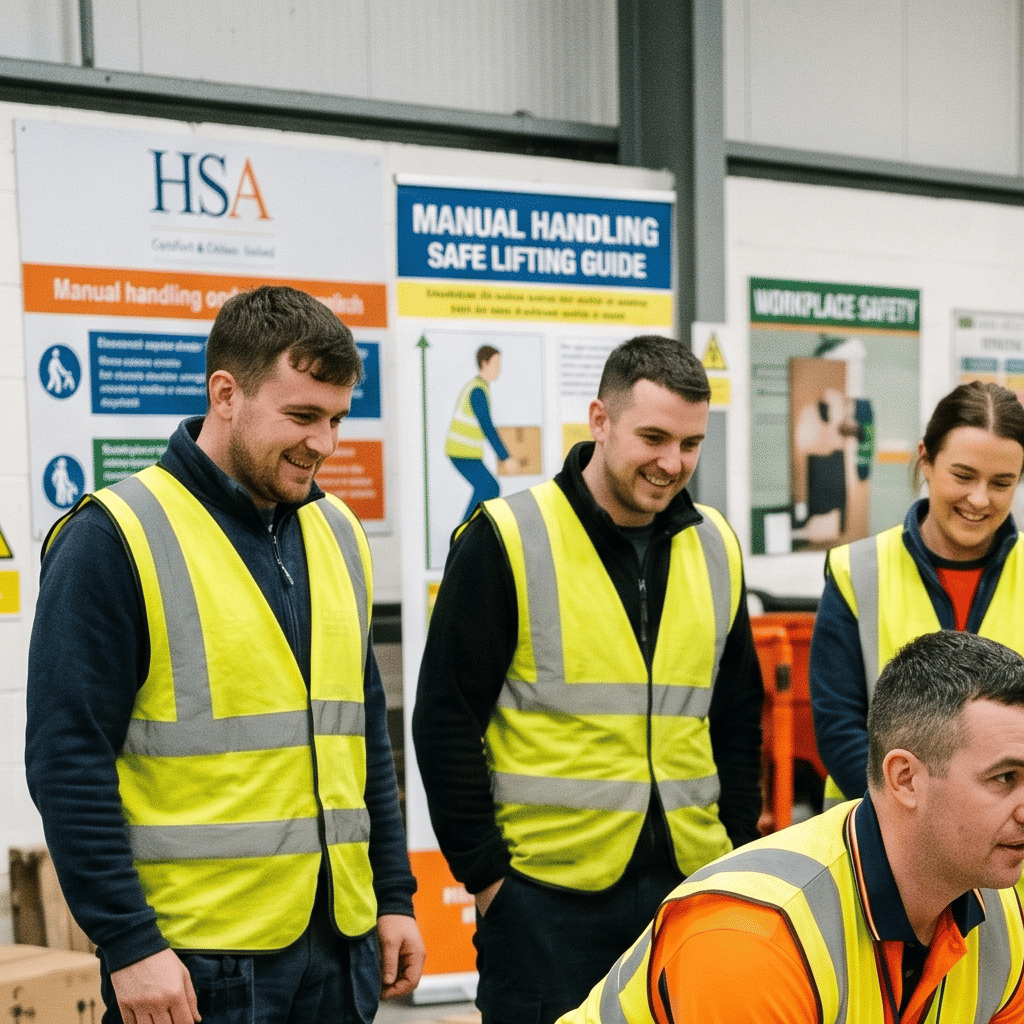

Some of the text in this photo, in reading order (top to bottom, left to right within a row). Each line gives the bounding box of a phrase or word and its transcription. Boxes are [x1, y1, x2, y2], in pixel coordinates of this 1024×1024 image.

[148, 148, 273, 221] HSA
[412, 203, 659, 247] MANUAL HANDLING
[427, 242, 647, 279] SAFE LIFTING GUIDE
[53, 277, 121, 304] Manual
[125, 281, 203, 313] handling
